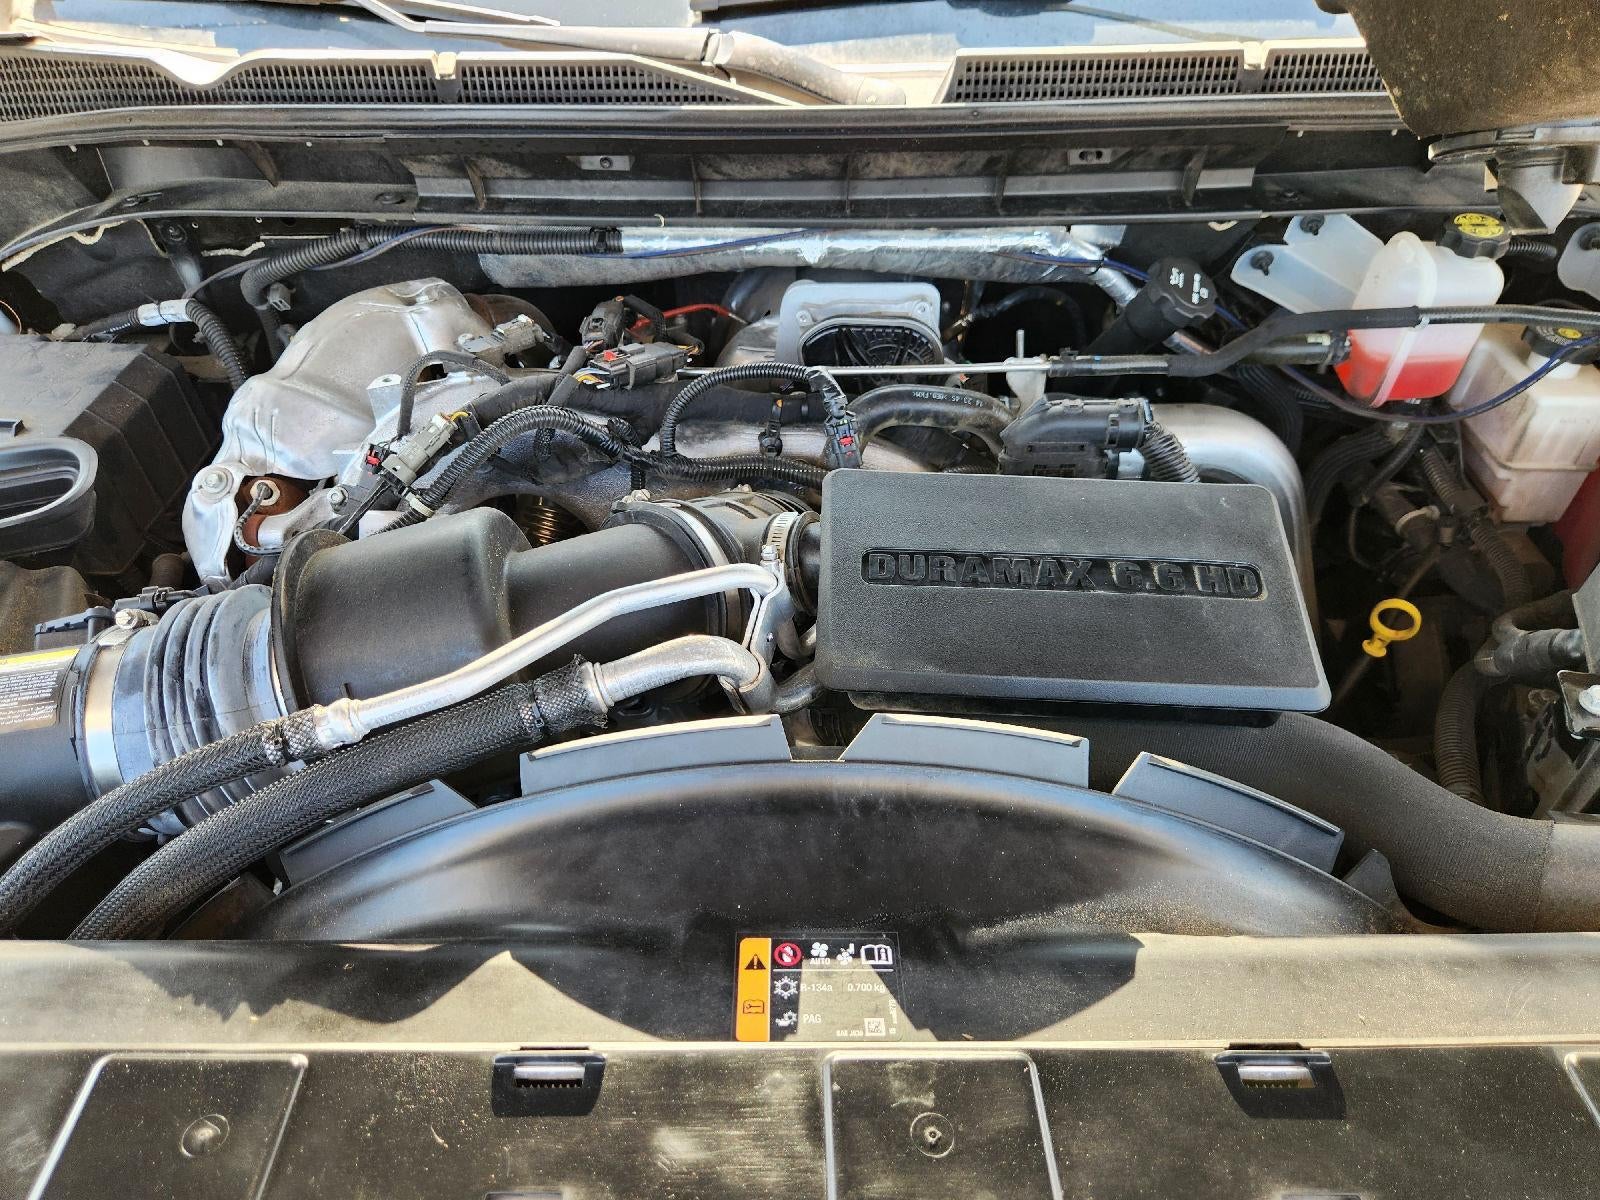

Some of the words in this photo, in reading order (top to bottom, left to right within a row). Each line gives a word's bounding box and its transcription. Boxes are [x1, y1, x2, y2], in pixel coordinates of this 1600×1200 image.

[868, 553, 1096, 588] DURAMAX
[1111, 561, 1186, 592] 6.6
[1196, 565, 1260, 595] HD
[810, 957, 831, 965] AUTO
[800, 983, 833, 992] R-134a
[847, 983, 873, 992] 0.700
[873, 983, 886, 993] kg
[803, 1014, 822, 1023] PAG
